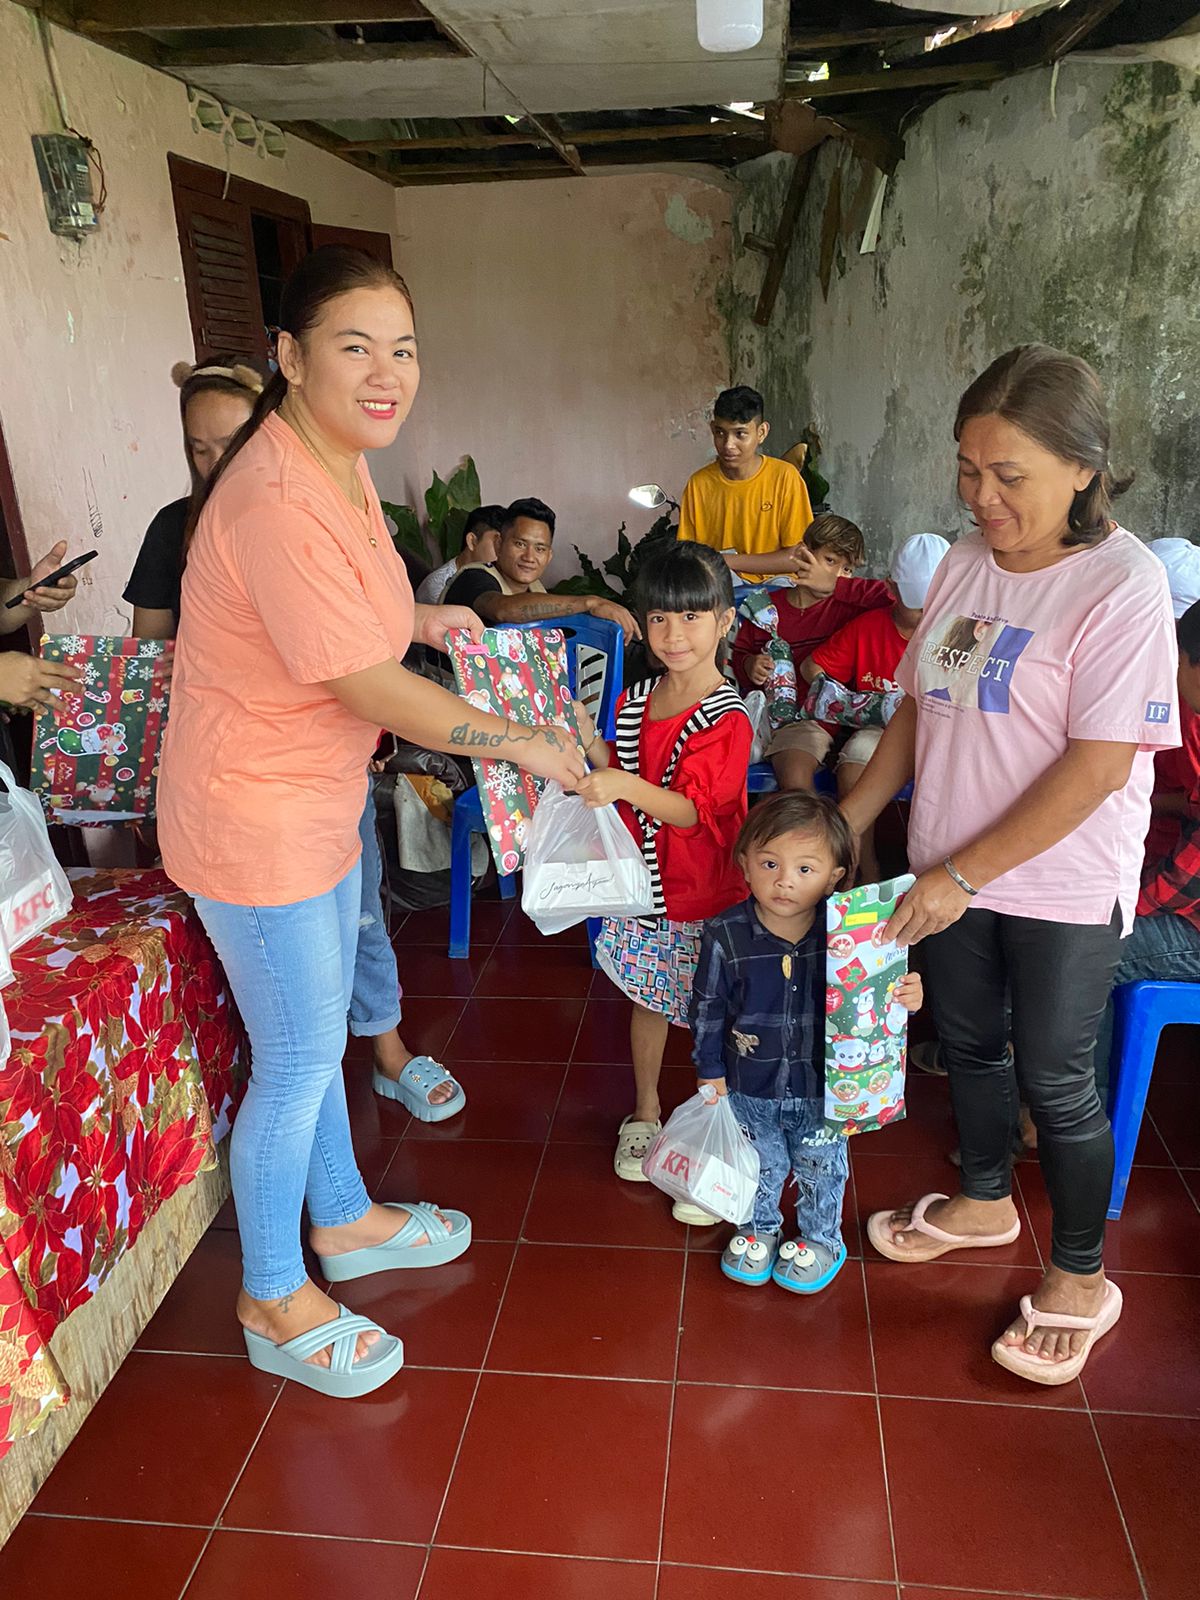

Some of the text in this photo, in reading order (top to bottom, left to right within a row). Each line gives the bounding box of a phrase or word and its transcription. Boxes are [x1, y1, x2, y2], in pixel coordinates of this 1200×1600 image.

[921, 641, 1010, 682] RESPECT
[1148, 704, 1168, 720] IF
[13, 883, 55, 934] KFC
[801, 1132, 839, 1147] PEOPL
